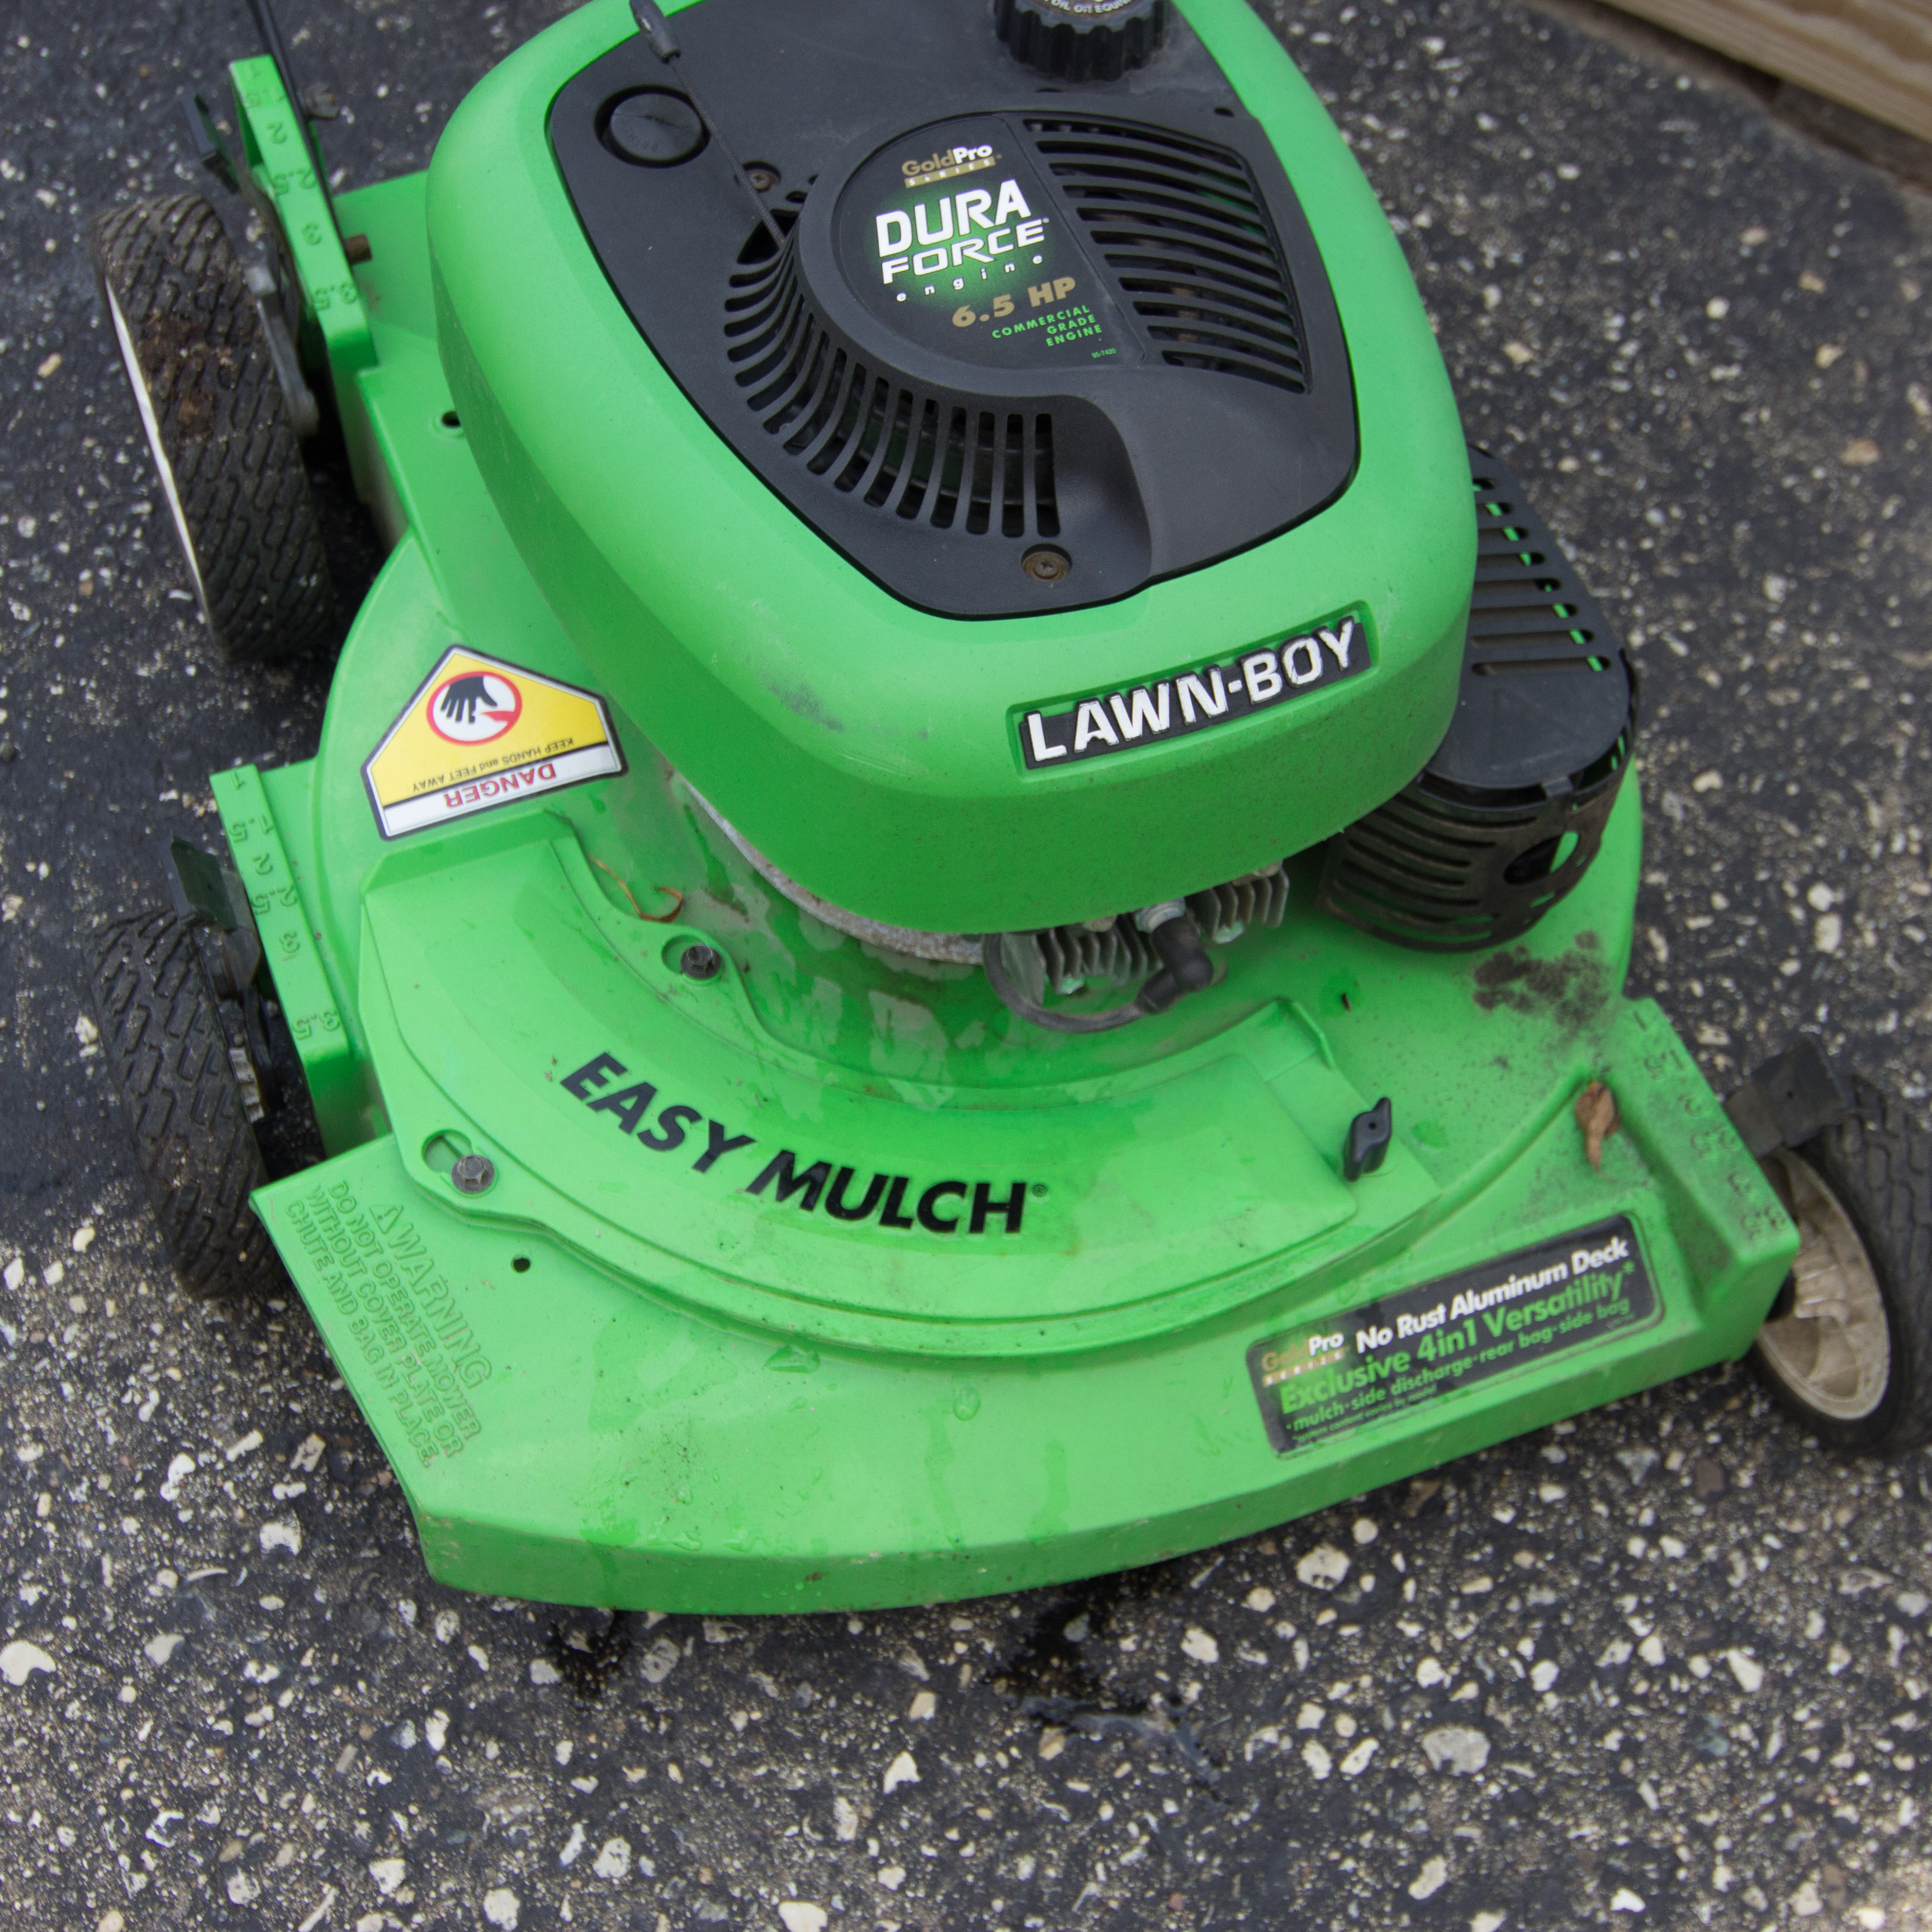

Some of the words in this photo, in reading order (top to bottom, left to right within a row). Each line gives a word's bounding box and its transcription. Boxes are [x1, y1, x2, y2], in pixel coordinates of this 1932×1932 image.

[902, 144, 993, 176] GoldPro
[909, 158, 990, 186] SERIES
[875, 179, 1031, 257] DURA
[882, 219, 1045, 285] FORCE
[896, 254, 1043, 302] engine
[952, 294, 1015, 328] 6.5
[1027, 277, 1076, 308] HP
[992, 305, 1090, 339] COMMERCIAL
[1046, 314, 1096, 334] GRADE
[1046, 324, 1102, 347] ENGINE
[1025, 615, 1355, 762] LAWN-BOY
[480, 759, 500, 771] and
[502, 747, 541, 766] HANDS
[544, 737, 574, 755] KEEP
[411, 775, 445, 793] AWAY
[444, 764, 556, 808] DANGER
[449, 765, 477, 782] FEET
[560, 1052, 757, 1175] EASY
[285, 1199, 335, 1273] CHUTE
[323, 1271, 359, 1316] AND
[348, 1315, 385, 1366] BAG
[374, 1364, 401, 1391] IN
[328, 1179, 358, 1214] DO
[346, 1214, 384, 1259] NOT
[372, 1260, 437, 1358] OPERATE
[425, 1355, 482, 1441] MOWER
[388, 1223, 493, 1390] WARNING
[1356, 1327, 1394, 1353] No
[1398, 1304, 1448, 1339] Rust
[1450, 1262, 1569, 1320] Aluminum
[1571, 1235, 1630, 1275] Deck
[305, 1185, 367, 1278] WITHOUT
[356, 1277, 409, 1354] COVER
[399, 1352, 445, 1424] PLATE
[433, 1423, 464, 1460] OR
[1280, 1351, 1411, 1414] Exclusive
[1417, 1318, 1478, 1361] 4in1
